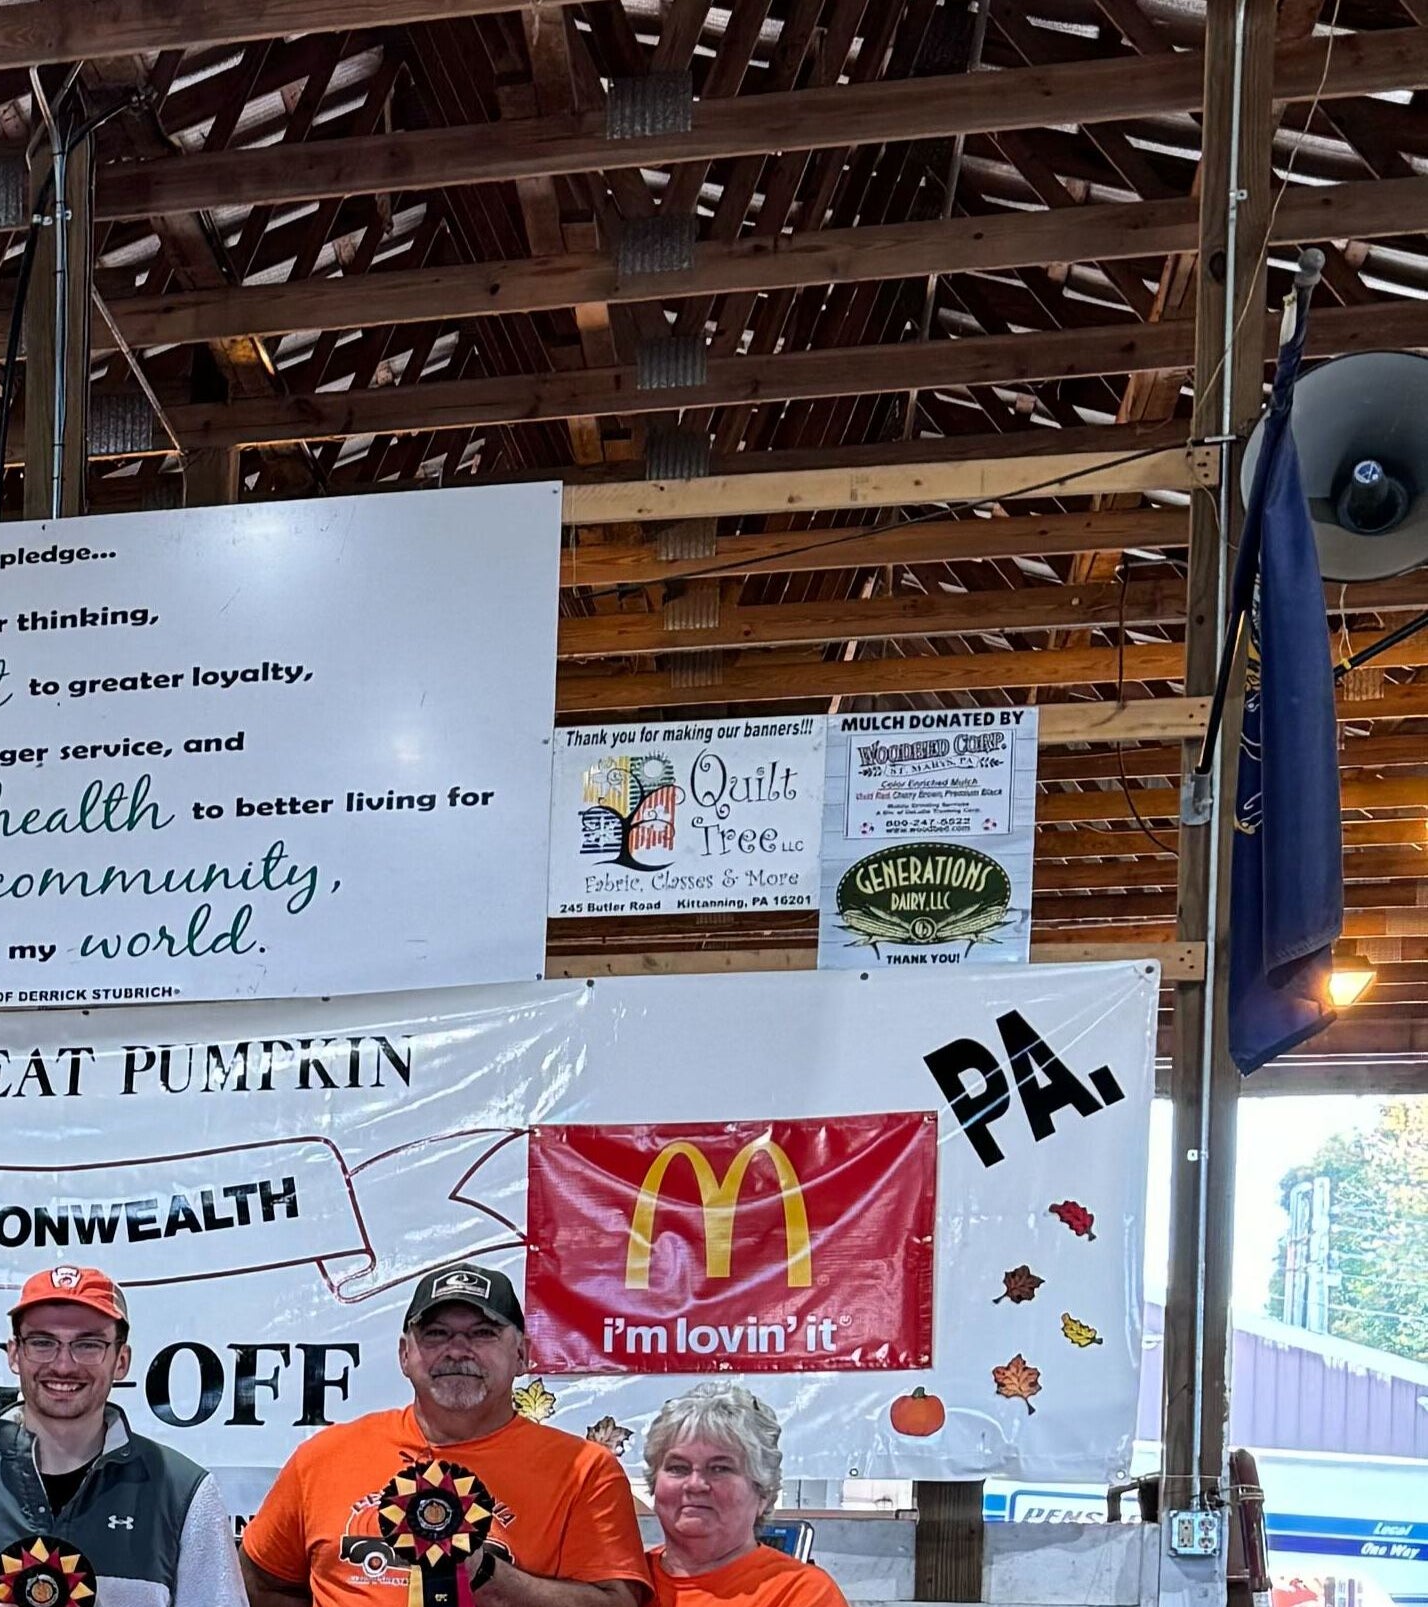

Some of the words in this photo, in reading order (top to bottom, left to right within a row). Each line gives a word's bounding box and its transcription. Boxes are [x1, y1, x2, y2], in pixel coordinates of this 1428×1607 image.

[0, 545, 117, 569] pledge...
[17, 606, 159, 634] thinking,
[29, 678, 60, 696] to
[68, 671, 184, 698] greater
[192, 661, 314, 688] loyalty,
[567, 730, 607, 746] Thank
[611, 732, 635, 748] you
[640, 726, 659, 743] for
[663, 725, 712, 743] making
[718, 725, 740, 739] our
[744, 719, 813, 738] banners!!!
[842, 716, 904, 731] MULCH
[910, 713, 994, 728] DONATED
[1000, 711, 1024, 725] BY
[59, 738, 173, 762] service,
[183, 731, 245, 753] and
[691, 749, 798, 819] Quilt
[192, 801, 224, 820] to
[236, 797, 334, 817] better
[346, 790, 436, 812] living
[447, 786, 495, 806] for
[692, 816, 778, 856] Tree
[783, 841, 804, 852] LLC
[652, 871, 712, 890] Classes
[722, 869, 738, 887] &
[746, 869, 798, 886] More
[856, 856, 993, 894] GENERATIONS
[560, 903, 582, 913] 245
[588, 902, 625, 912] Butler
[630, 901, 660, 910] Road
[678, 899, 747, 909] Kittanning,
[752, 898, 768, 906] PA
[774, 896, 811, 905] 16201
[9, 943, 56, 962] my
[80, 904, 266, 959] world.
[887, 955, 927, 964] THANK
[931, 954, 960, 963] YOU!
[19, 988, 87, 1001] DERRICK
[92, 986, 173, 1000] STUBRICH
[119, 1035, 414, 1096] PUMPKIN
[923, 1009, 1125, 1168] PA.
[602, 1317, 668, 1354] i'm
[676, 1317, 798, 1355] lovin'
[1373, 1522, 1413, 1536] Local
[1361, 1542, 1387, 1555] One
[1390, 1544, 1420, 1559] Way
